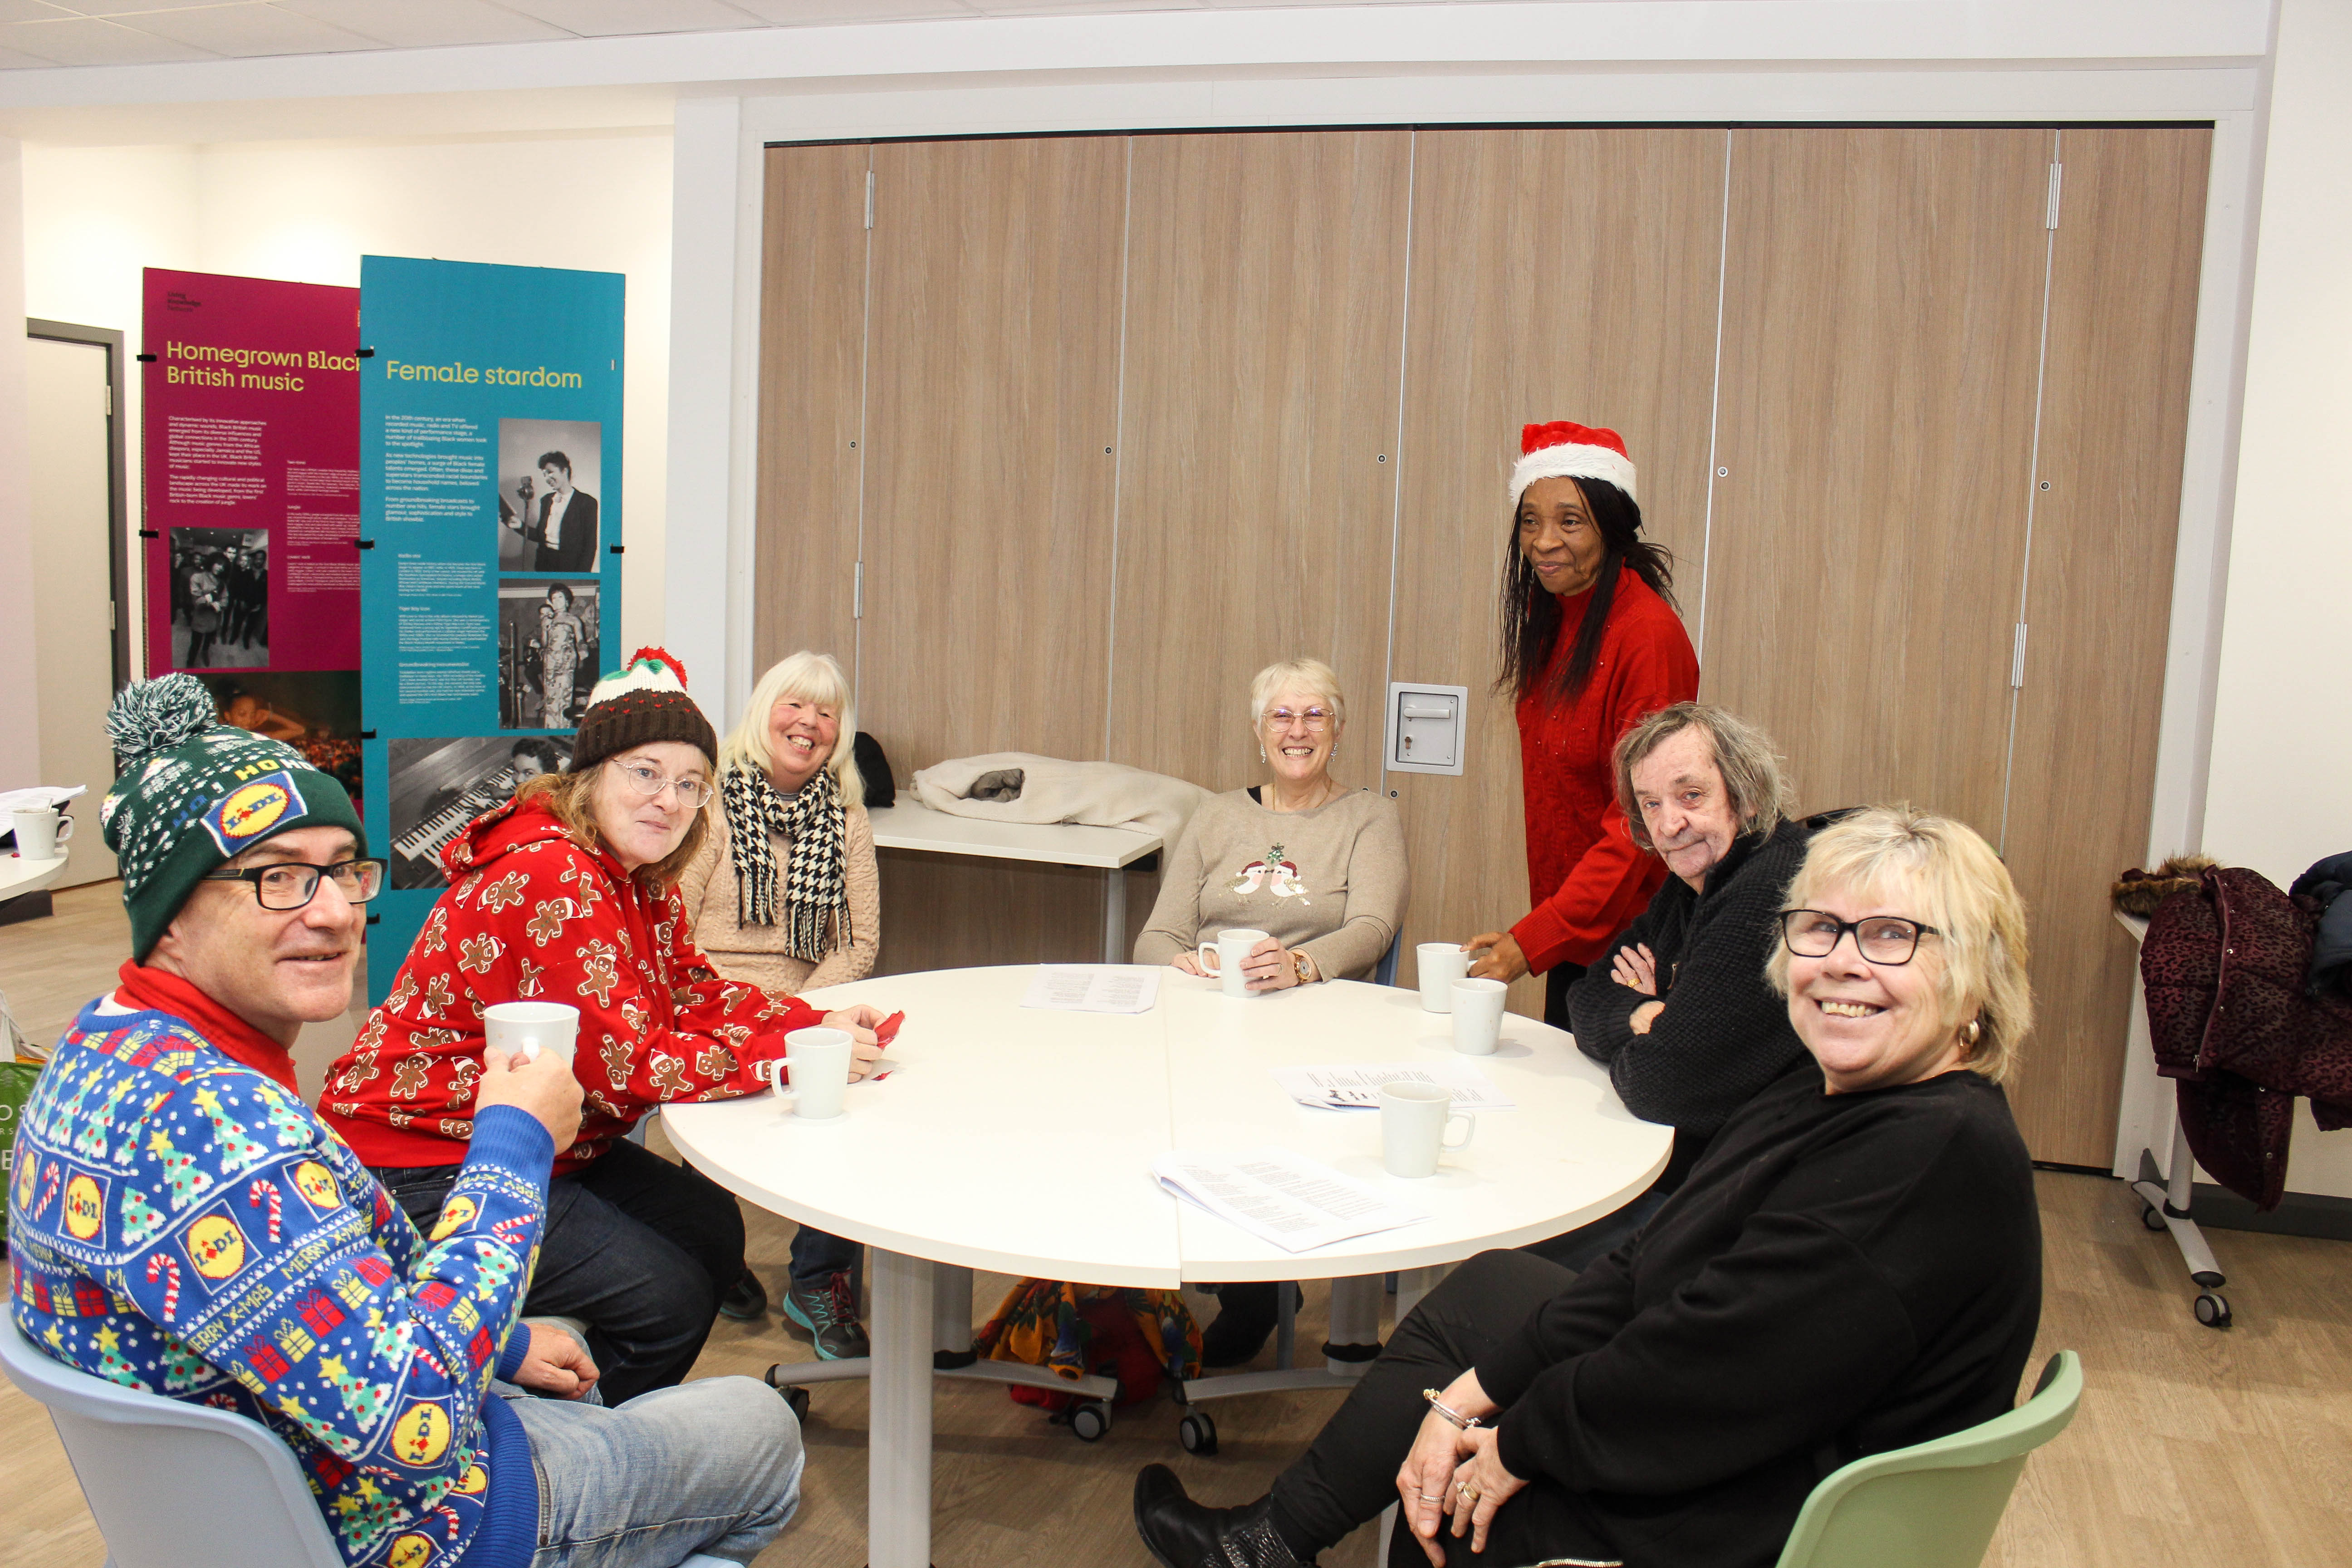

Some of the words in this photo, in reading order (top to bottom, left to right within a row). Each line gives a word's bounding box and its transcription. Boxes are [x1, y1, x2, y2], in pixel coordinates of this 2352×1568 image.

[167, 340, 302, 368] Homegrown
[167, 365, 235, 387] British
[241, 372, 304, 392] music
[386, 360, 478, 384] Female
[484, 365, 582, 389] stardom
[234, 759, 280, 781] HO
[279, 758, 317, 772] HO
[280, 1238, 331, 1280] MERRY
[186, 1318, 228, 1354] ERRY
[222, 1283, 274, 1326] X-MAS
